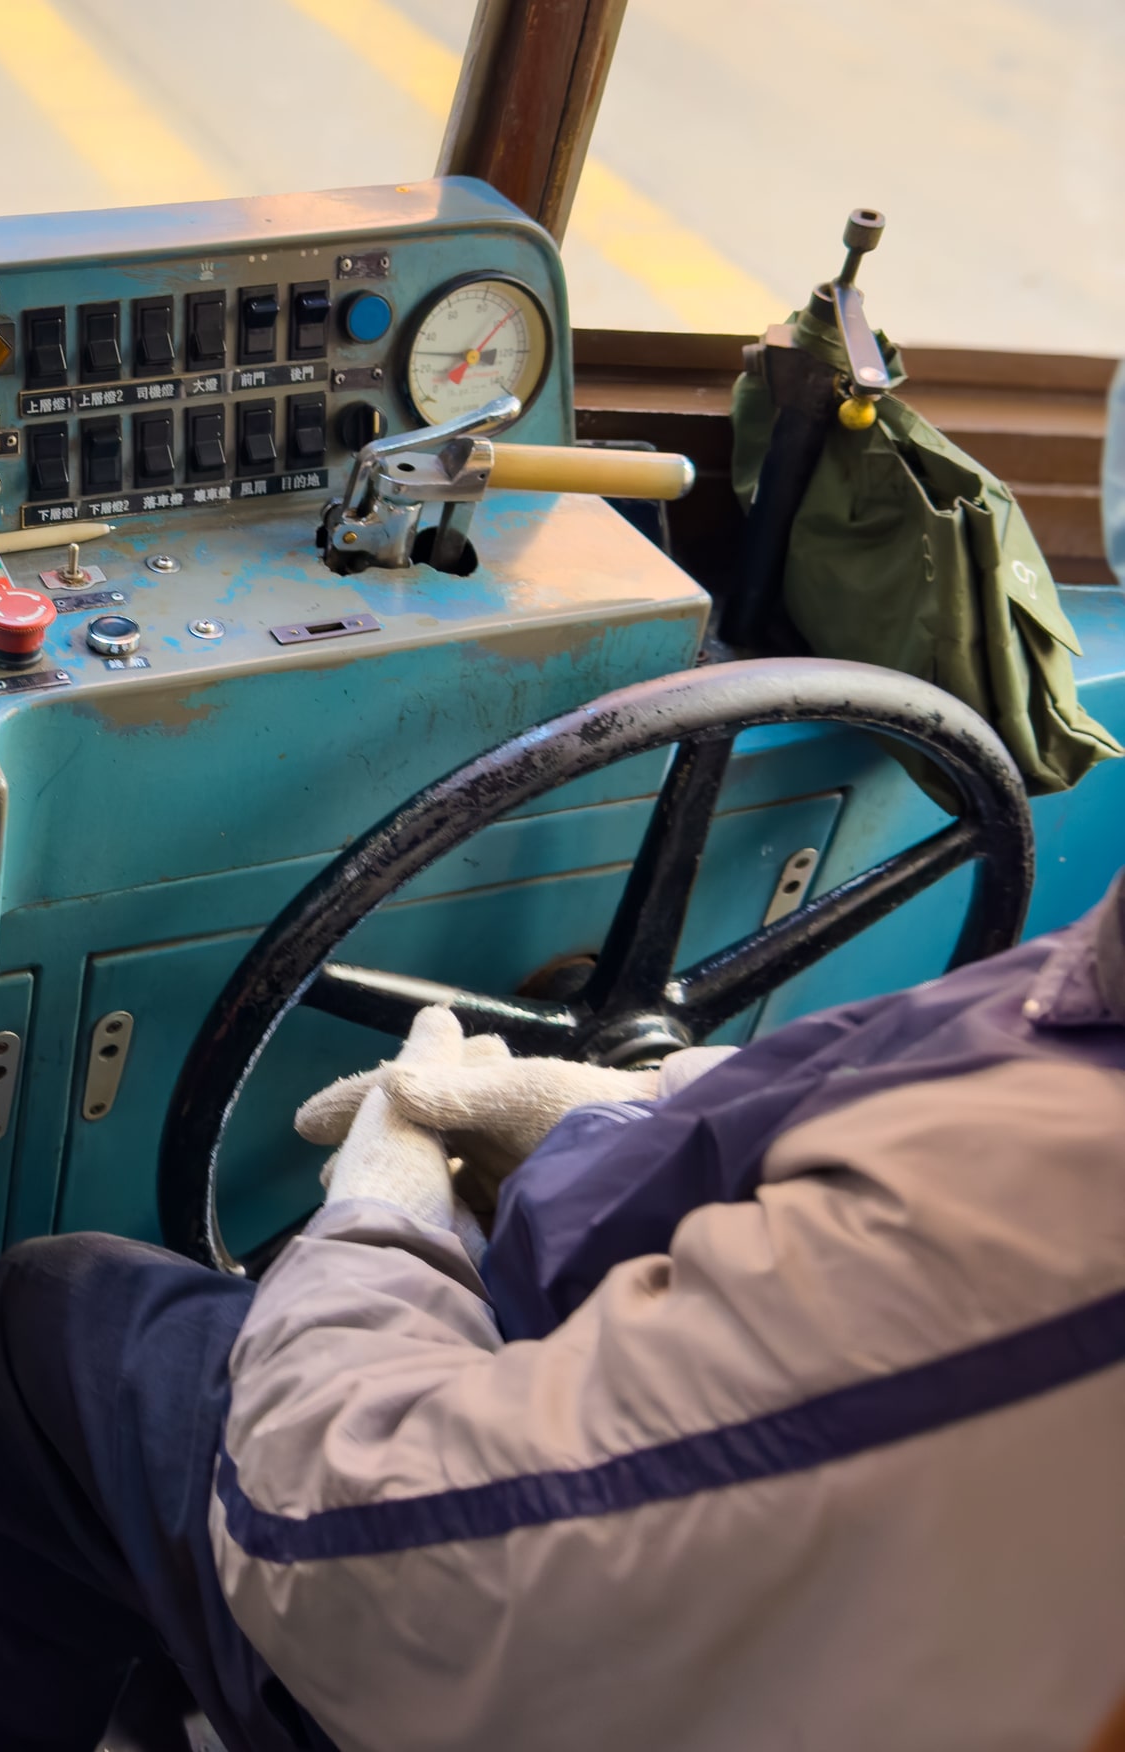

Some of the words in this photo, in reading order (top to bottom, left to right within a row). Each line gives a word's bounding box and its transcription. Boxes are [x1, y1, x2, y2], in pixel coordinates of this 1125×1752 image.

[78, 389, 124, 407] 上層燈2
[240, 371, 266, 387] 前門
[290, 365, 315, 381] 後門
[281, 473, 320, 491] 目的地
